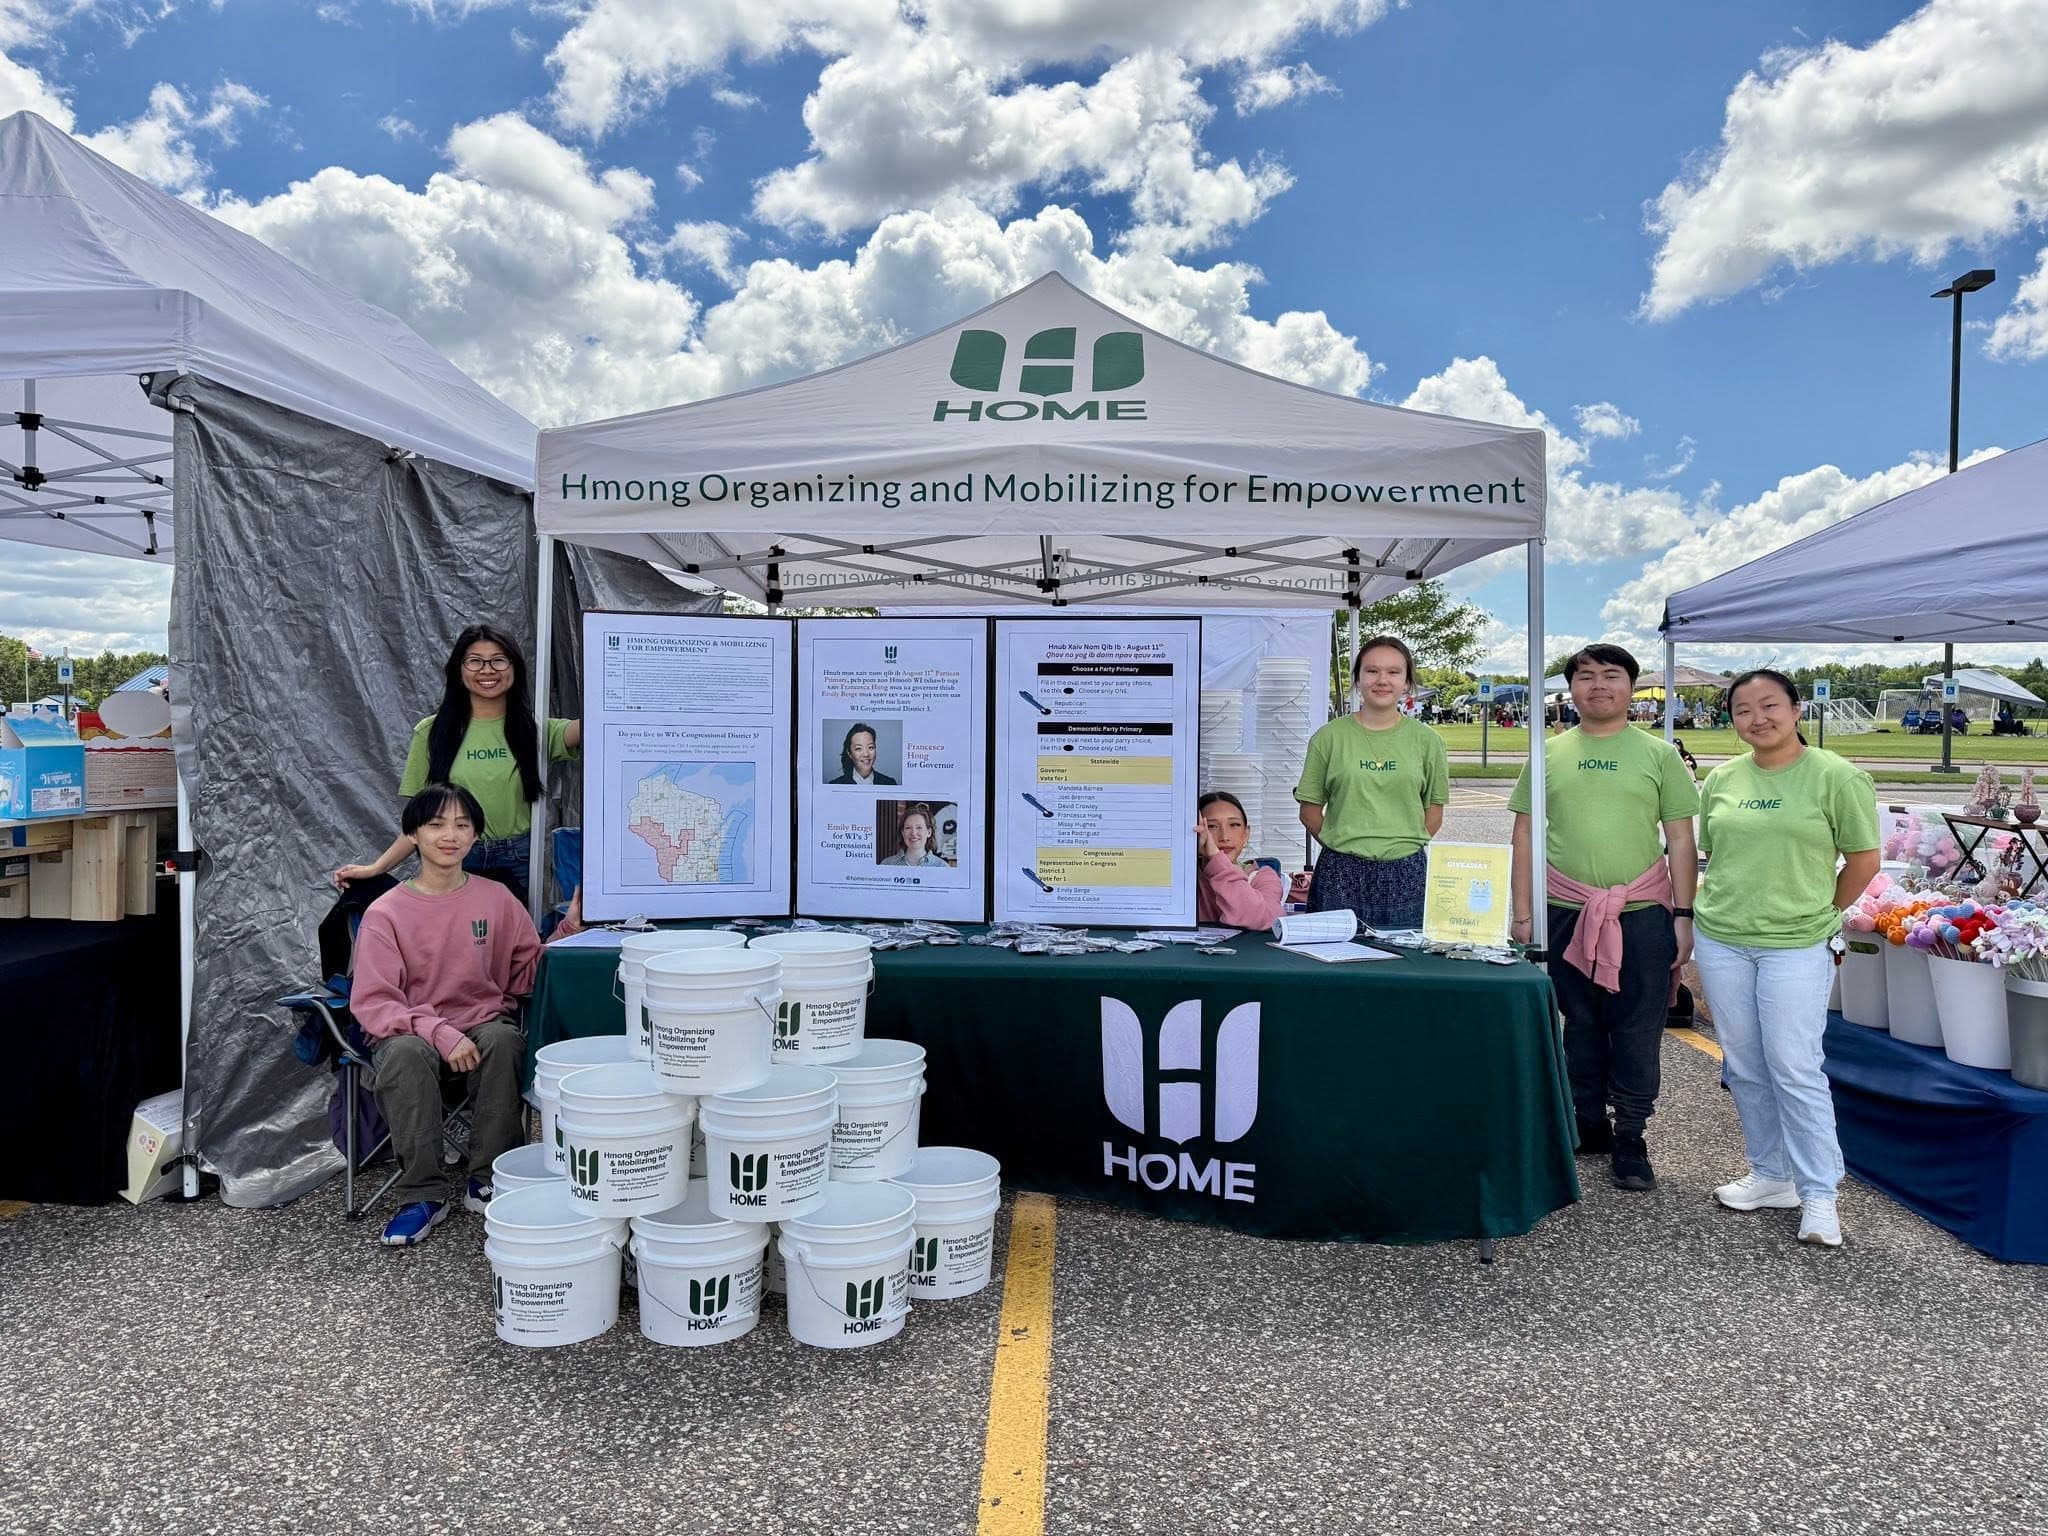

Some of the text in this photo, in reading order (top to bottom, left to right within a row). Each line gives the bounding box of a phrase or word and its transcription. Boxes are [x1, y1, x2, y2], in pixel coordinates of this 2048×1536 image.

[932, 399, 1148, 422] HOME
[561, 473, 1526, 509] Hmong Organizing and Mobilizing for Empowerment
[627, 637, 659, 645] HMONG
[661, 639, 711, 647] ORGANIZING
[721, 640, 767, 648] MOBILIZING
[1100, 643, 1113, 651] Qib
[1127, 643, 1149, 651] August
[1103, 726, 1118, 734] Party
[1120, 726, 1142, 734] Primary
[907, 743, 944, 751] Francesca
[467, 748, 507, 760] HOME
[907, 752, 929, 761] Hong
[1360, 760, 1396, 771] HOME
[1578, 759, 1618, 771] HOME
[1738, 799, 1783, 809] HOME
[827, 824, 872, 832] Emily Berge
[832, 832, 843, 840] for
[820, 841, 872, 850] Congressional
[1090, 860, 1117, 868] Congress
[818, 1008, 850, 1017] Mobilizing
[813, 1014, 856, 1025] Empowerment
[674, 1027, 715, 1036] Organizing
[662, 1033, 696, 1044] Mobilizing
[659, 1041, 706, 1051] Empowerment
[851, 1121, 888, 1130] Organizing
[832, 1136, 881, 1144] Empowerment
[604, 1144, 673, 1160] Hmong Organizing
[618, 1157, 656, 1167] Mobilizing
[788, 1154, 819, 1168] Mobilizing
[612, 1162, 666, 1176] Empowerment
[781, 1159, 824, 1176] Empowerment
[1103, 1141, 1256, 1204] HOME
[571, 1184, 599, 1201] HOME
[730, 1193, 767, 1206] HOME
[943, 1237, 967, 1245] Hmong
[955, 1240, 983, 1252] Mobilizing
[949, 1244, 988, 1260] Empowerment
[735, 1266, 755, 1280] Hmong
[505, 1280, 573, 1292] Hmong Organizing
[515, 1290, 553, 1299] Mobilizing
[511, 1297, 564, 1306] Empowerment
[844, 1318, 882, 1334] HOME
